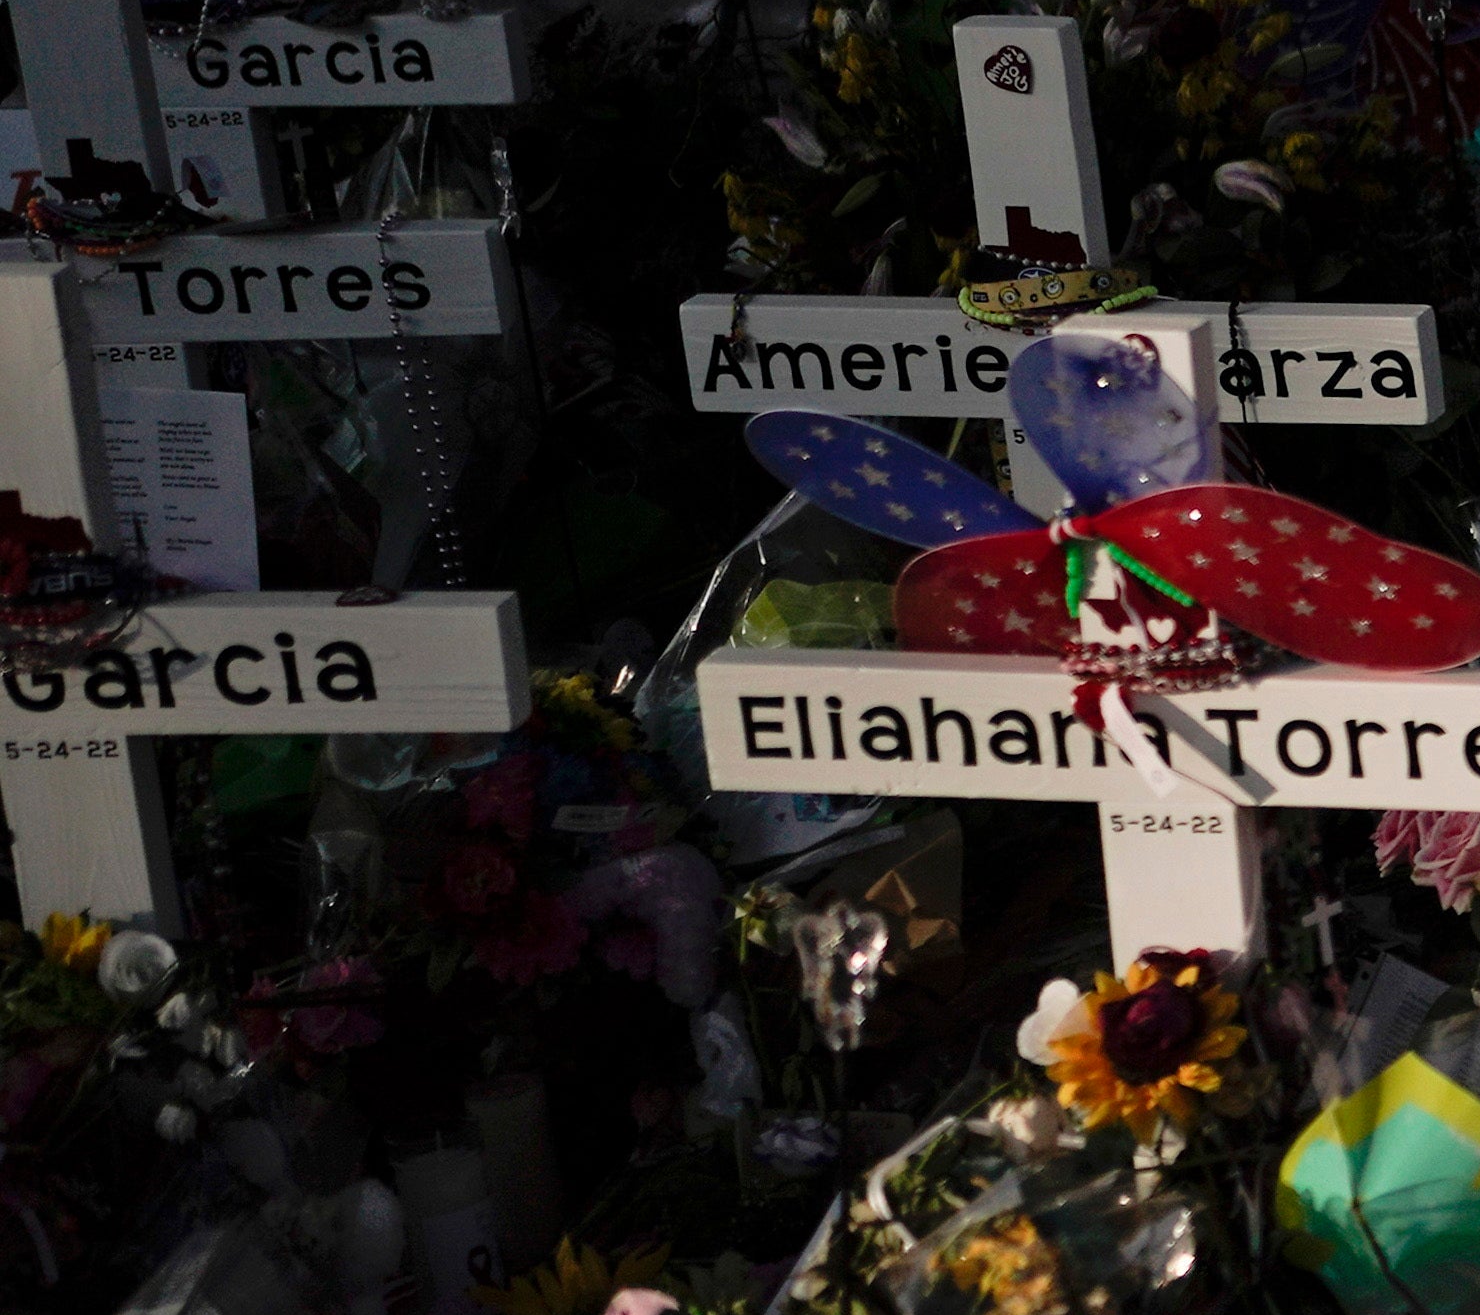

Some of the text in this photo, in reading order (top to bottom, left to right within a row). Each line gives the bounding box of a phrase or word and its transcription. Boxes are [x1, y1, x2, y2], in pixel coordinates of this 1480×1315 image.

[186, 34, 434, 87] Garcia
[165, 112, 243, 128] 5-24-22
[118, 261, 432, 315] Torres
[96, 346, 176, 362] -24-22
[703, 334, 1008, 394] Amerie
[1218, 347, 1417, 401] arza
[5, 632, 377, 712] Garcia
[5, 740, 118, 759] 5-24-22
[1111, 815, 1222, 833] 5-24-22
